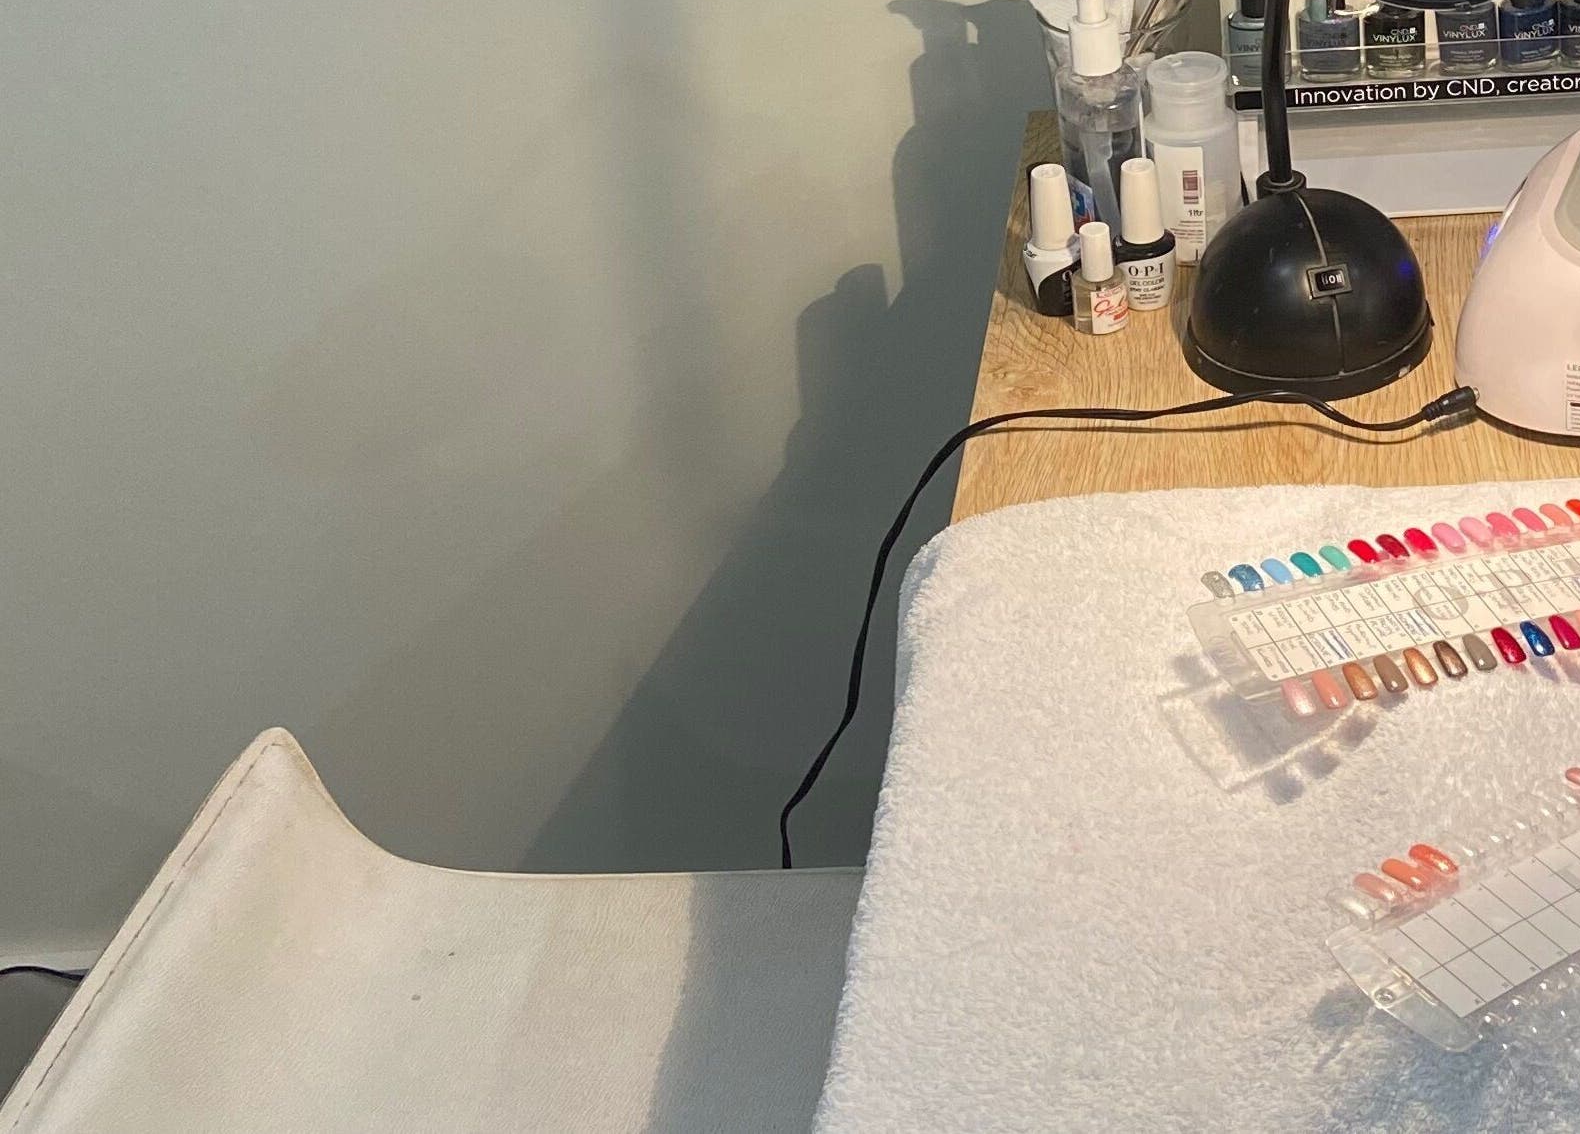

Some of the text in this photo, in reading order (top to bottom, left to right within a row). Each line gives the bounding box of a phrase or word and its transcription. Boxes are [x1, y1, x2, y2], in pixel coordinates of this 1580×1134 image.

[1373, 34, 1416, 43] VINYLUX
[1443, 29, 1486, 39] VINYLUX
[1514, 26, 1555, 40] VINYLUX
[1294, 84, 1407, 105] Innovation
[1413, 82, 1440, 101] by
[1446, 78, 1500, 97] CND,
